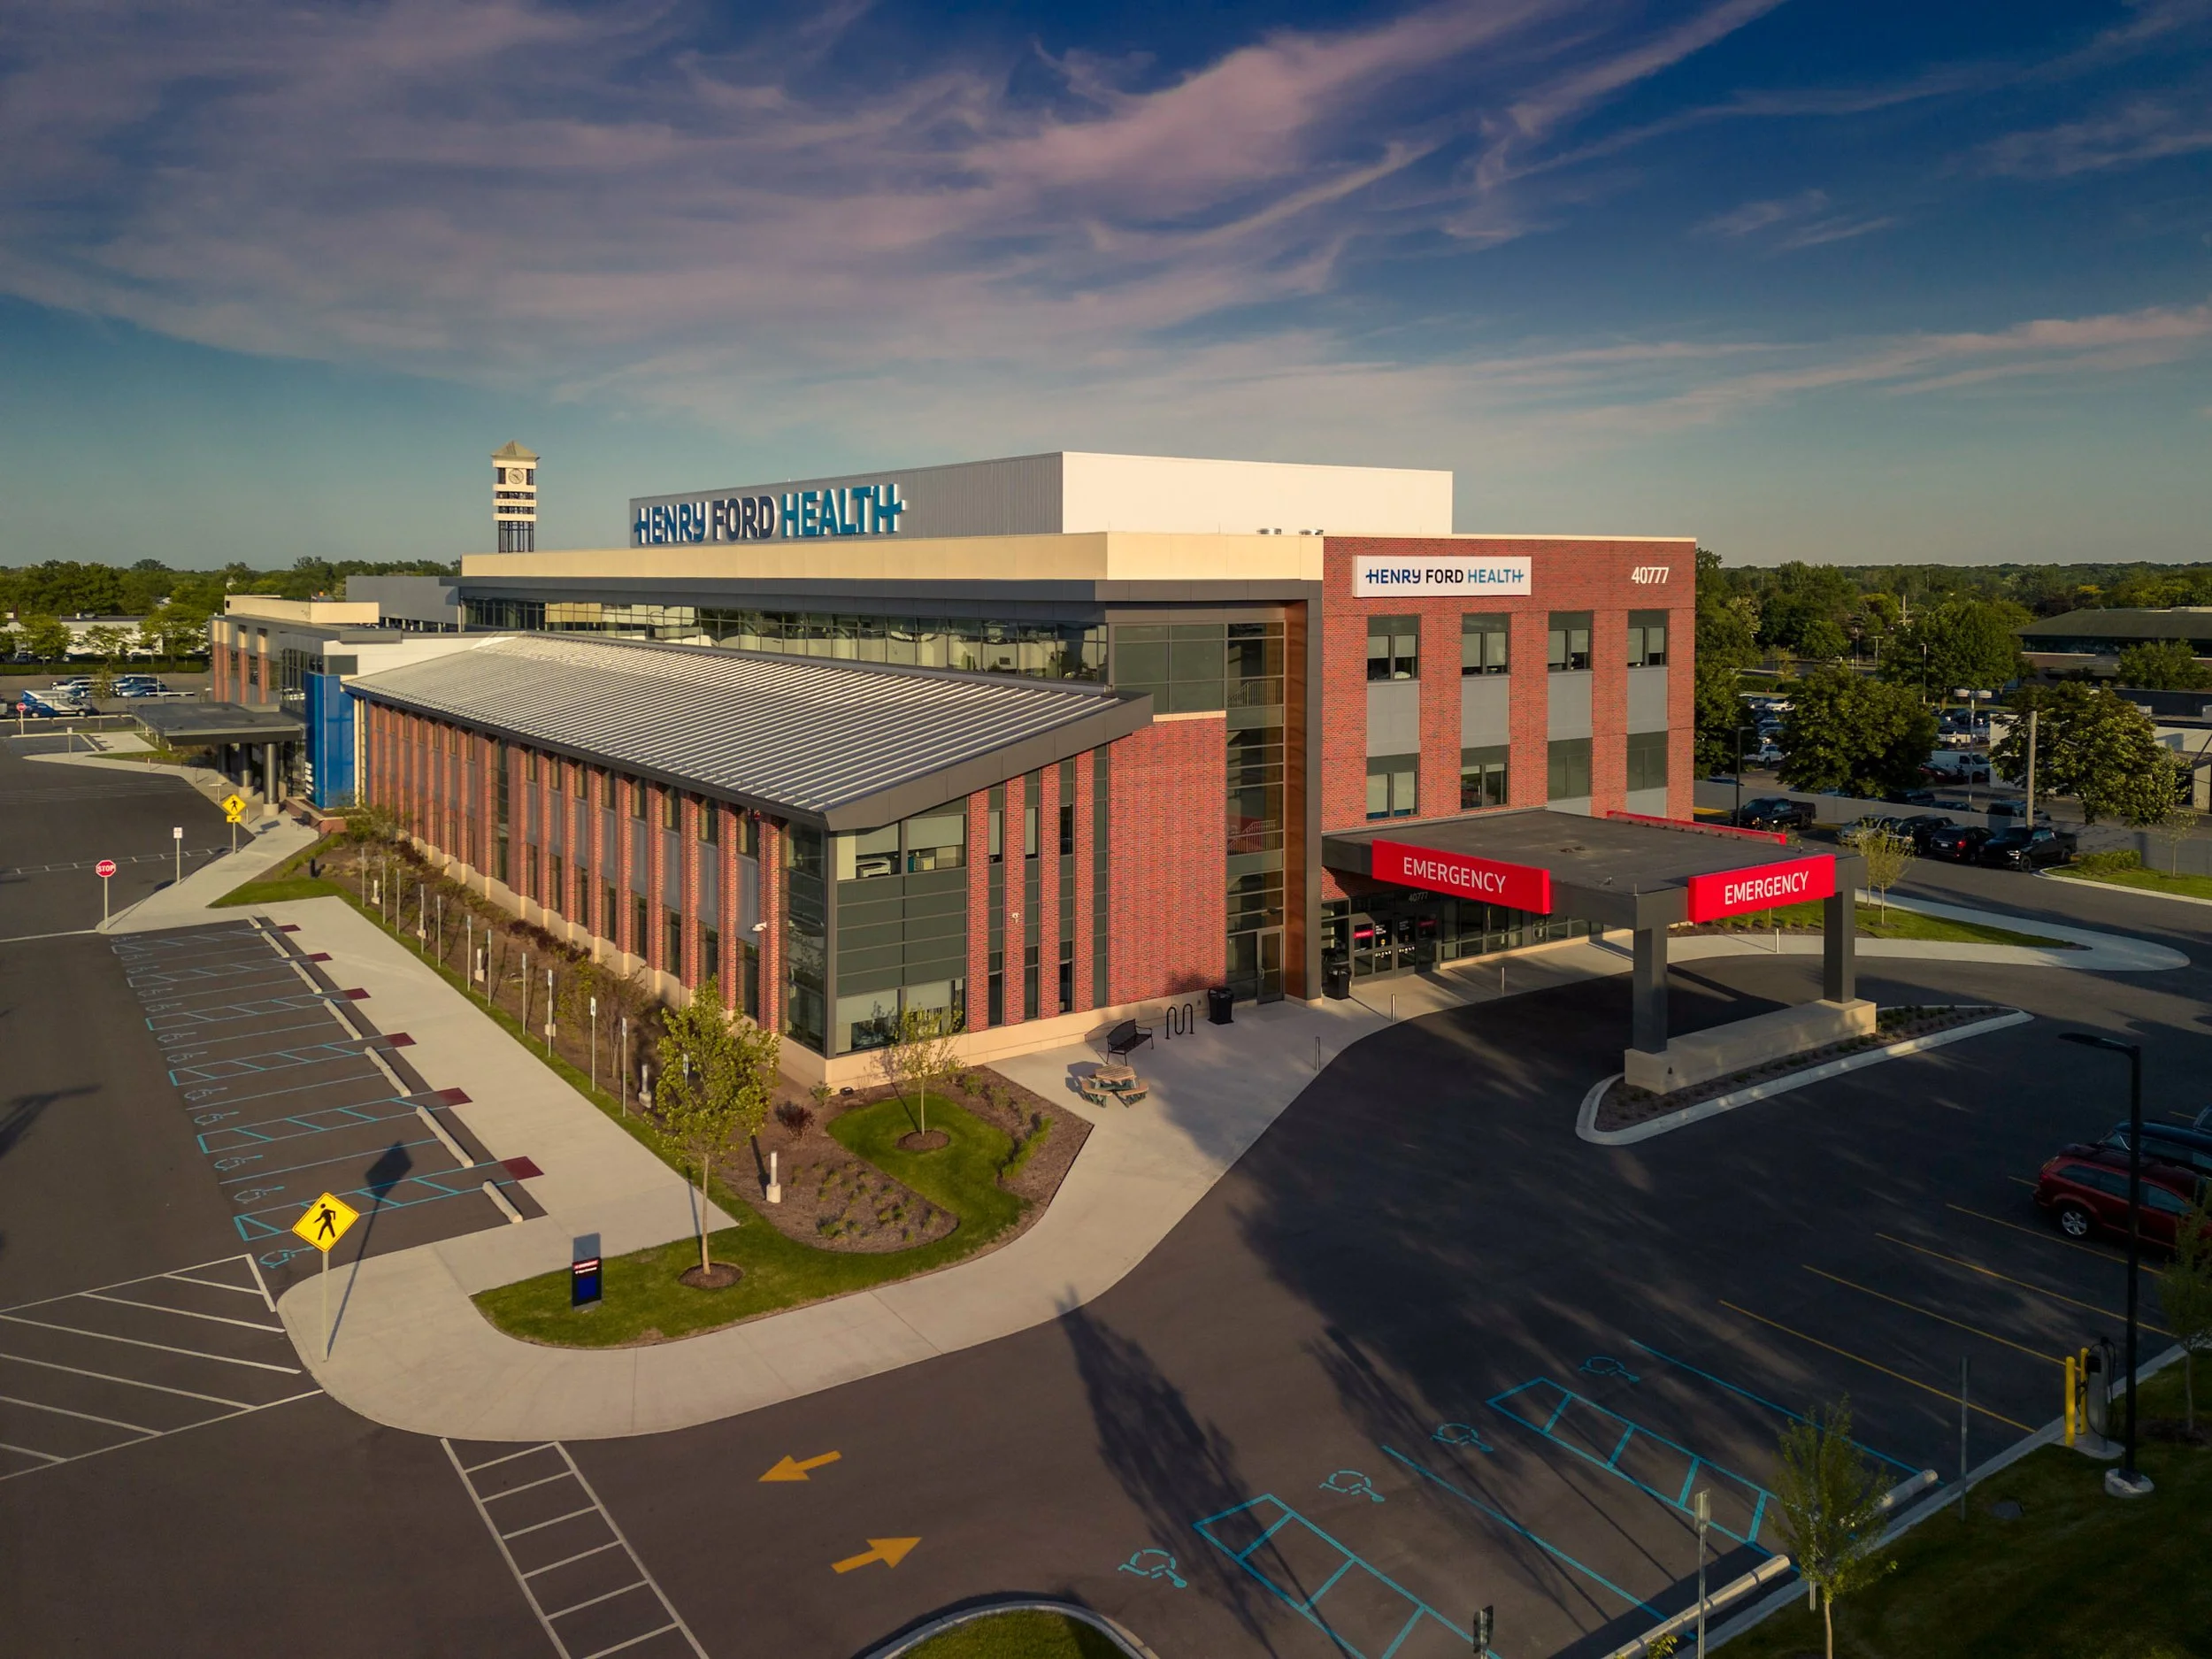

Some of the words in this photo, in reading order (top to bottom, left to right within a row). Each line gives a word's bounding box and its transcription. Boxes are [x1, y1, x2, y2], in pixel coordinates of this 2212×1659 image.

[634, 501, 709, 545] HENRY
[711, 495, 777, 541] FORD
[780, 483, 908, 539] HEALTH
[1365, 569, 1421, 584] HENRY
[1425, 569, 1463, 584] FORD
[1468, 569, 1524, 583] HEALTH
[1631, 566, 1670, 584] 40777
[1403, 856, 1506, 894] EMERGENCY
[1724, 871, 1809, 905] EMERGENCY
[1408, 891, 1428, 902] 40777
